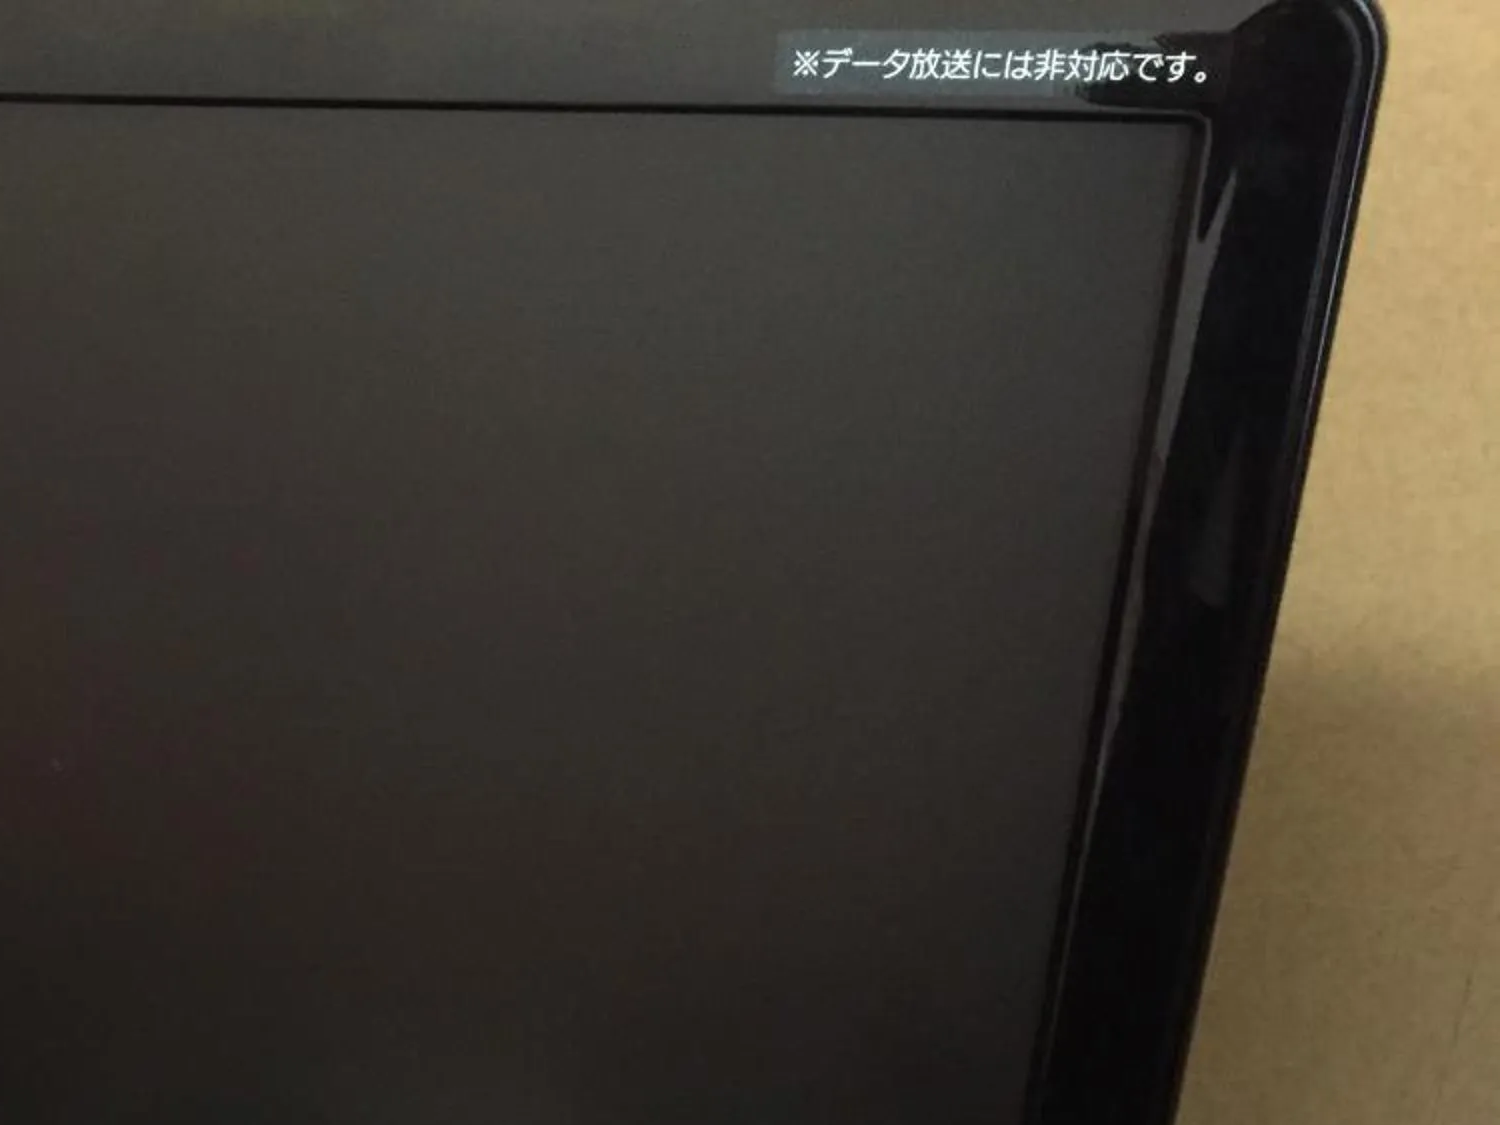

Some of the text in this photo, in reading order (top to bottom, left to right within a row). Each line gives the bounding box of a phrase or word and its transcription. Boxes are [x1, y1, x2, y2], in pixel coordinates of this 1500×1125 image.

[792, 47, 1209, 84] ※データ放送には非対応です。
